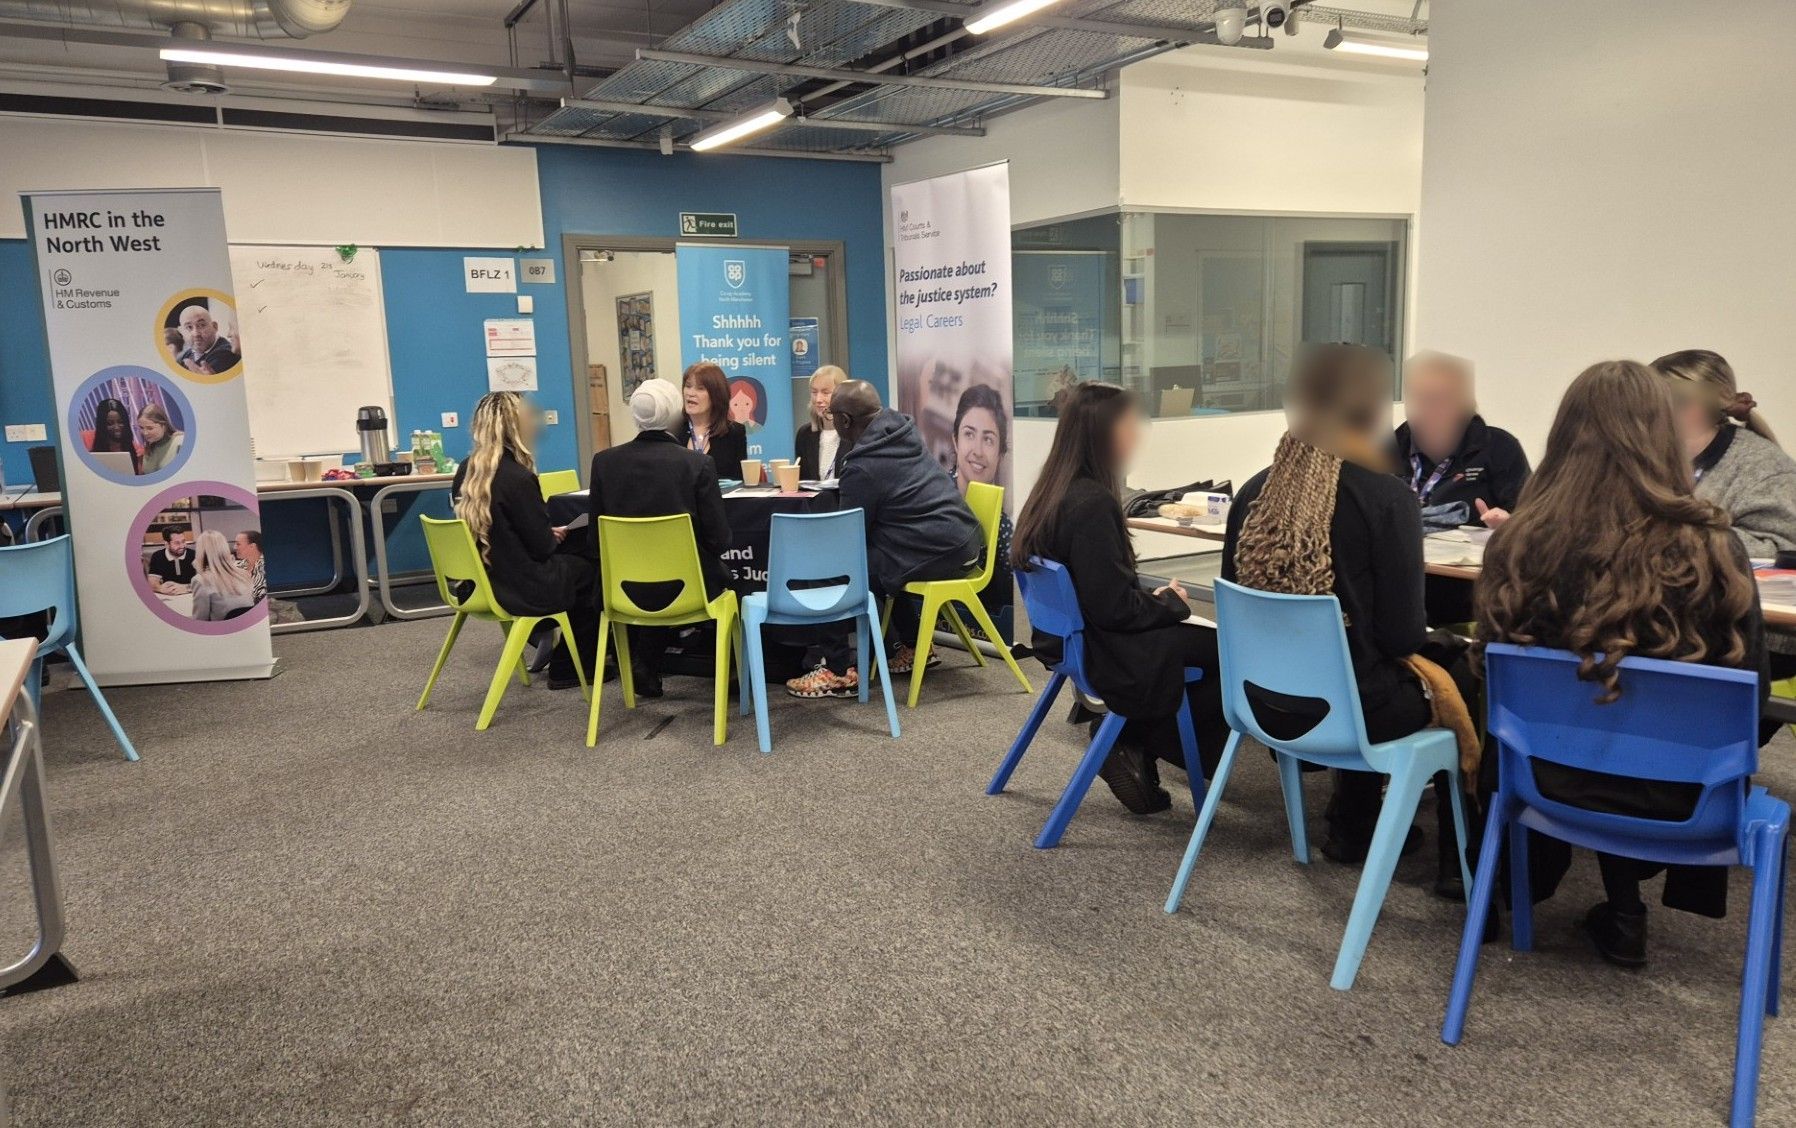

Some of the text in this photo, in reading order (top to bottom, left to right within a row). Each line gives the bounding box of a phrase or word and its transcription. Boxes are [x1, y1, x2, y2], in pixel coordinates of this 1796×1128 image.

[44, 210, 165, 229] HMRC in the
[699, 220, 716, 228] Fire
[46, 235, 162, 253] North West
[471, 269, 510, 280] BFLZ 1
[899, 260, 986, 283] Passionate about
[55, 288, 120, 298] HM Revenue
[900, 282, 998, 308] the justice system?
[57, 299, 112, 309] & Customs
[712, 314, 761, 329] Shhhhh
[900, 313, 963, 334] Legal Careers
[692, 333, 782, 351] Thank you for
[742, 352, 777, 366] silent
